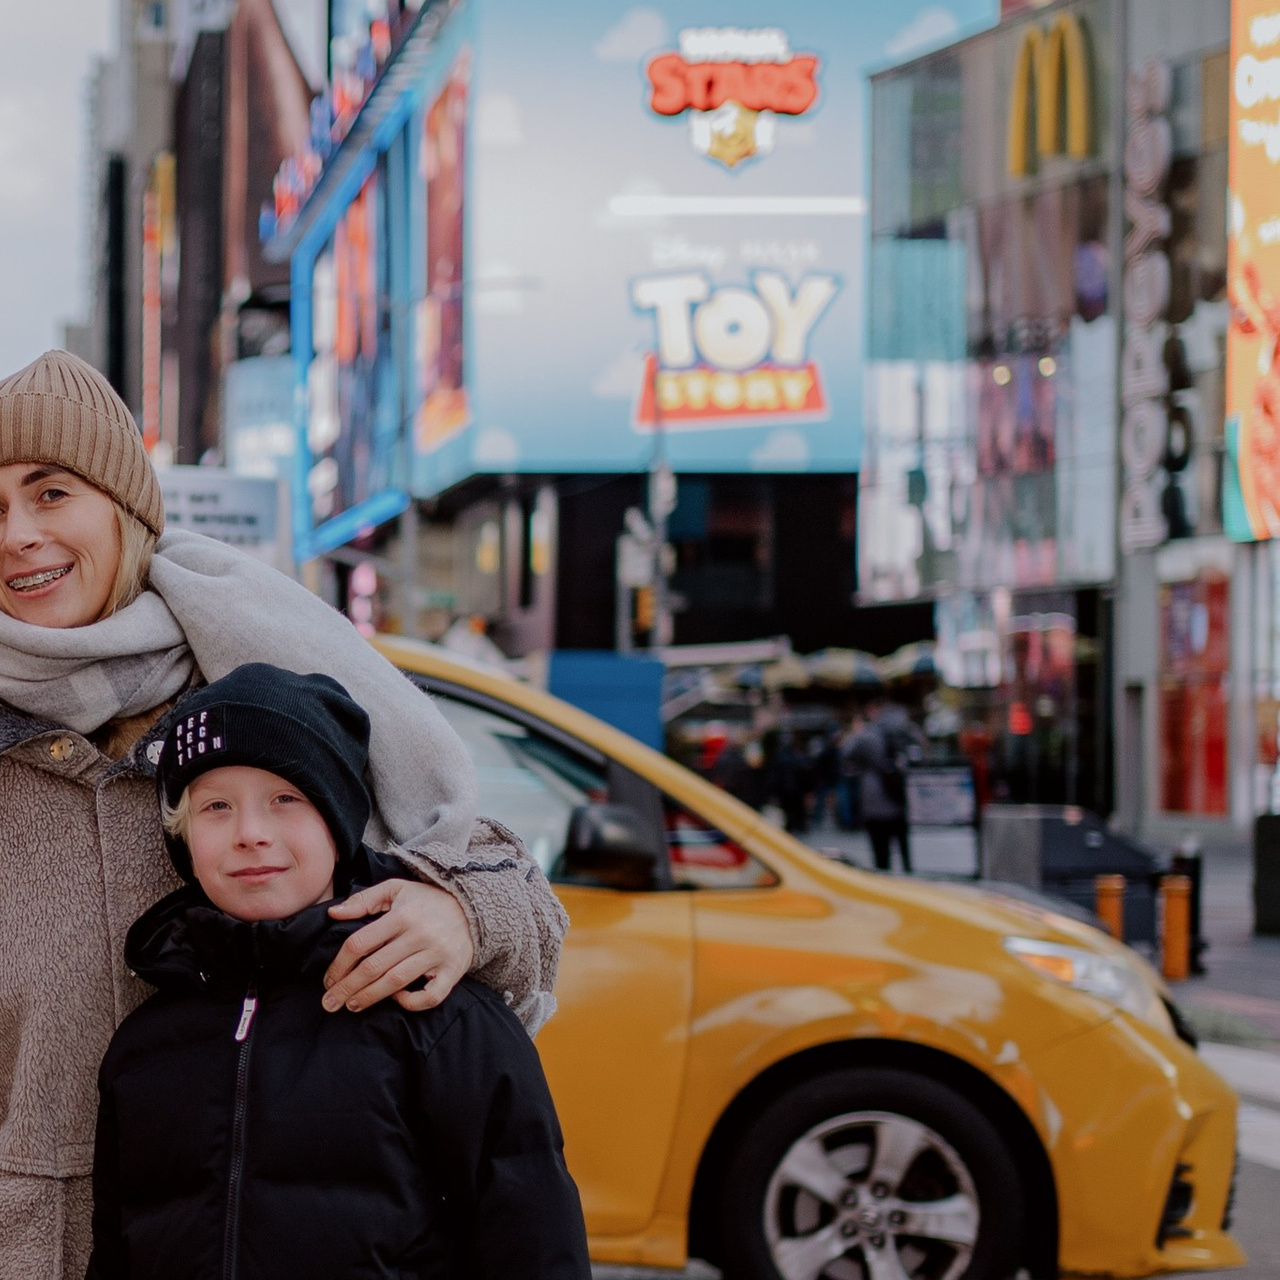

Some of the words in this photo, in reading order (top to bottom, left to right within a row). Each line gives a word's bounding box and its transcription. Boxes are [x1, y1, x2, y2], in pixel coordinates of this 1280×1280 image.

[646, 53, 818, 116] STARS
[632, 272, 842, 371] TOY
[656, 365, 816, 412] STORY
